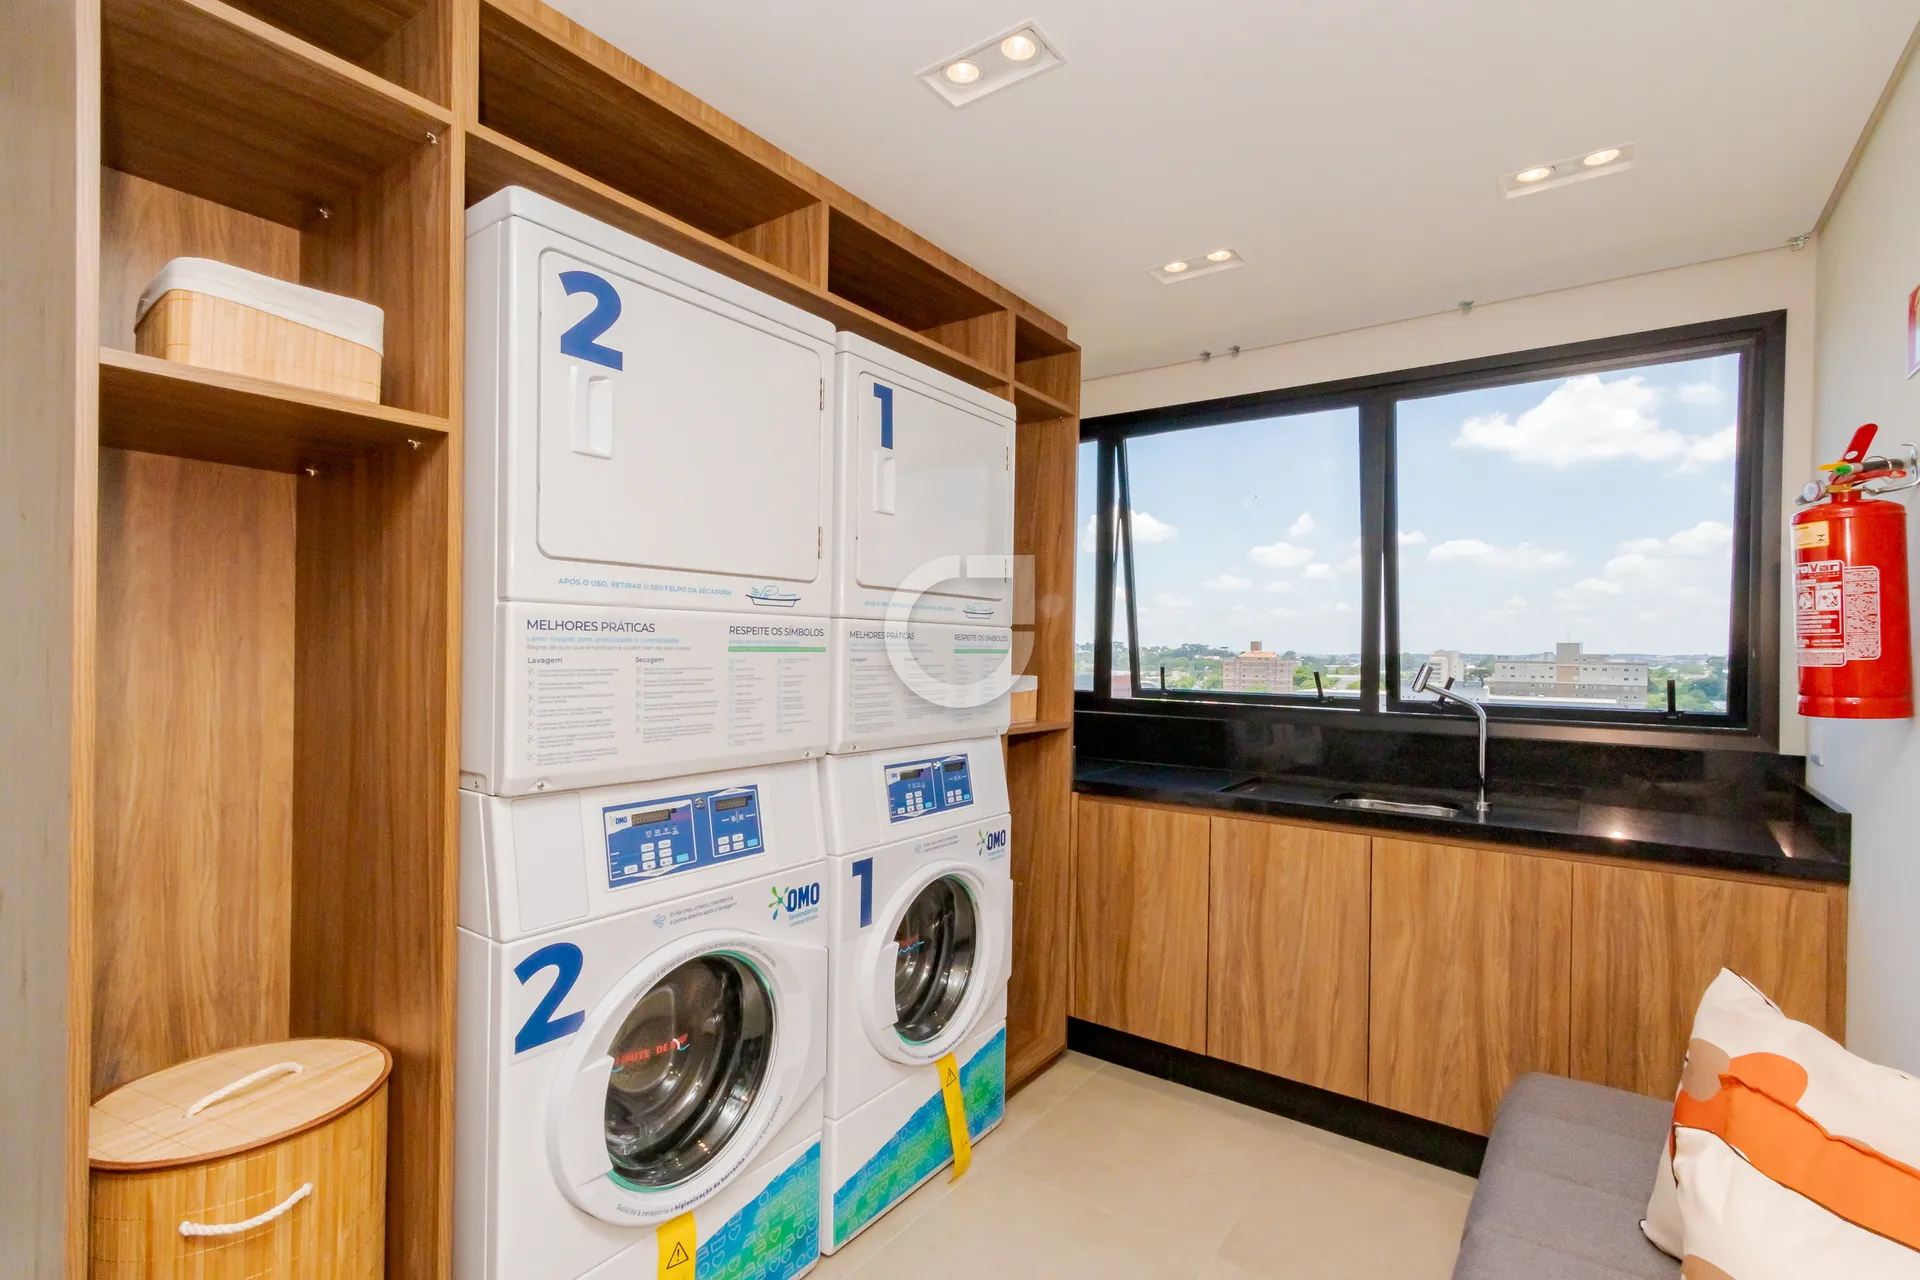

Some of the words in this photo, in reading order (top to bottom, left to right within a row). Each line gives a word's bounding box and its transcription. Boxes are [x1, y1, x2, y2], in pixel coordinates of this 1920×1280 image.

[558, 270, 623, 372] 2
[873, 382, 893, 450] 1
[558, 577, 581, 586] APÓS
[591, 580, 609, 588] USO,
[611, 581, 641, 590] RETIRAR
[643, 583, 649, 591] O
[665, 585, 686, 593] FELPO
[688, 586, 697, 594] DA
[698, 587, 732, 596] SECADORA
[526, 619, 598, 632] MELHORES
[601, 620, 656, 633] PRÁTICAS
[729, 625, 770, 636] RESPEITE
[771, 627, 783, 636] OS
[784, 625, 824, 637] SÍMBOLOS
[850, 631, 885, 640] MELHORES
[886, 631, 915, 640] PRÁTICAS
[954, 633, 977, 641] RESPEITE
[528, 657, 562, 665] Lavagem
[635, 656, 664, 664] Secagem
[987, 829, 1006, 851] OMO
[786, 882, 820, 913] OMO
[852, 857, 873, 929] 1
[513, 942, 586, 1056] 2
[656, 1042, 668, 1055] DE
[616, 1204, 637, 1216] Solicite
[641, 1206, 669, 1217] zeladoria
[674, 1186, 714, 1212] higienização
[713, 1180, 722, 1190] da
[720, 1157, 746, 1184] borracha
